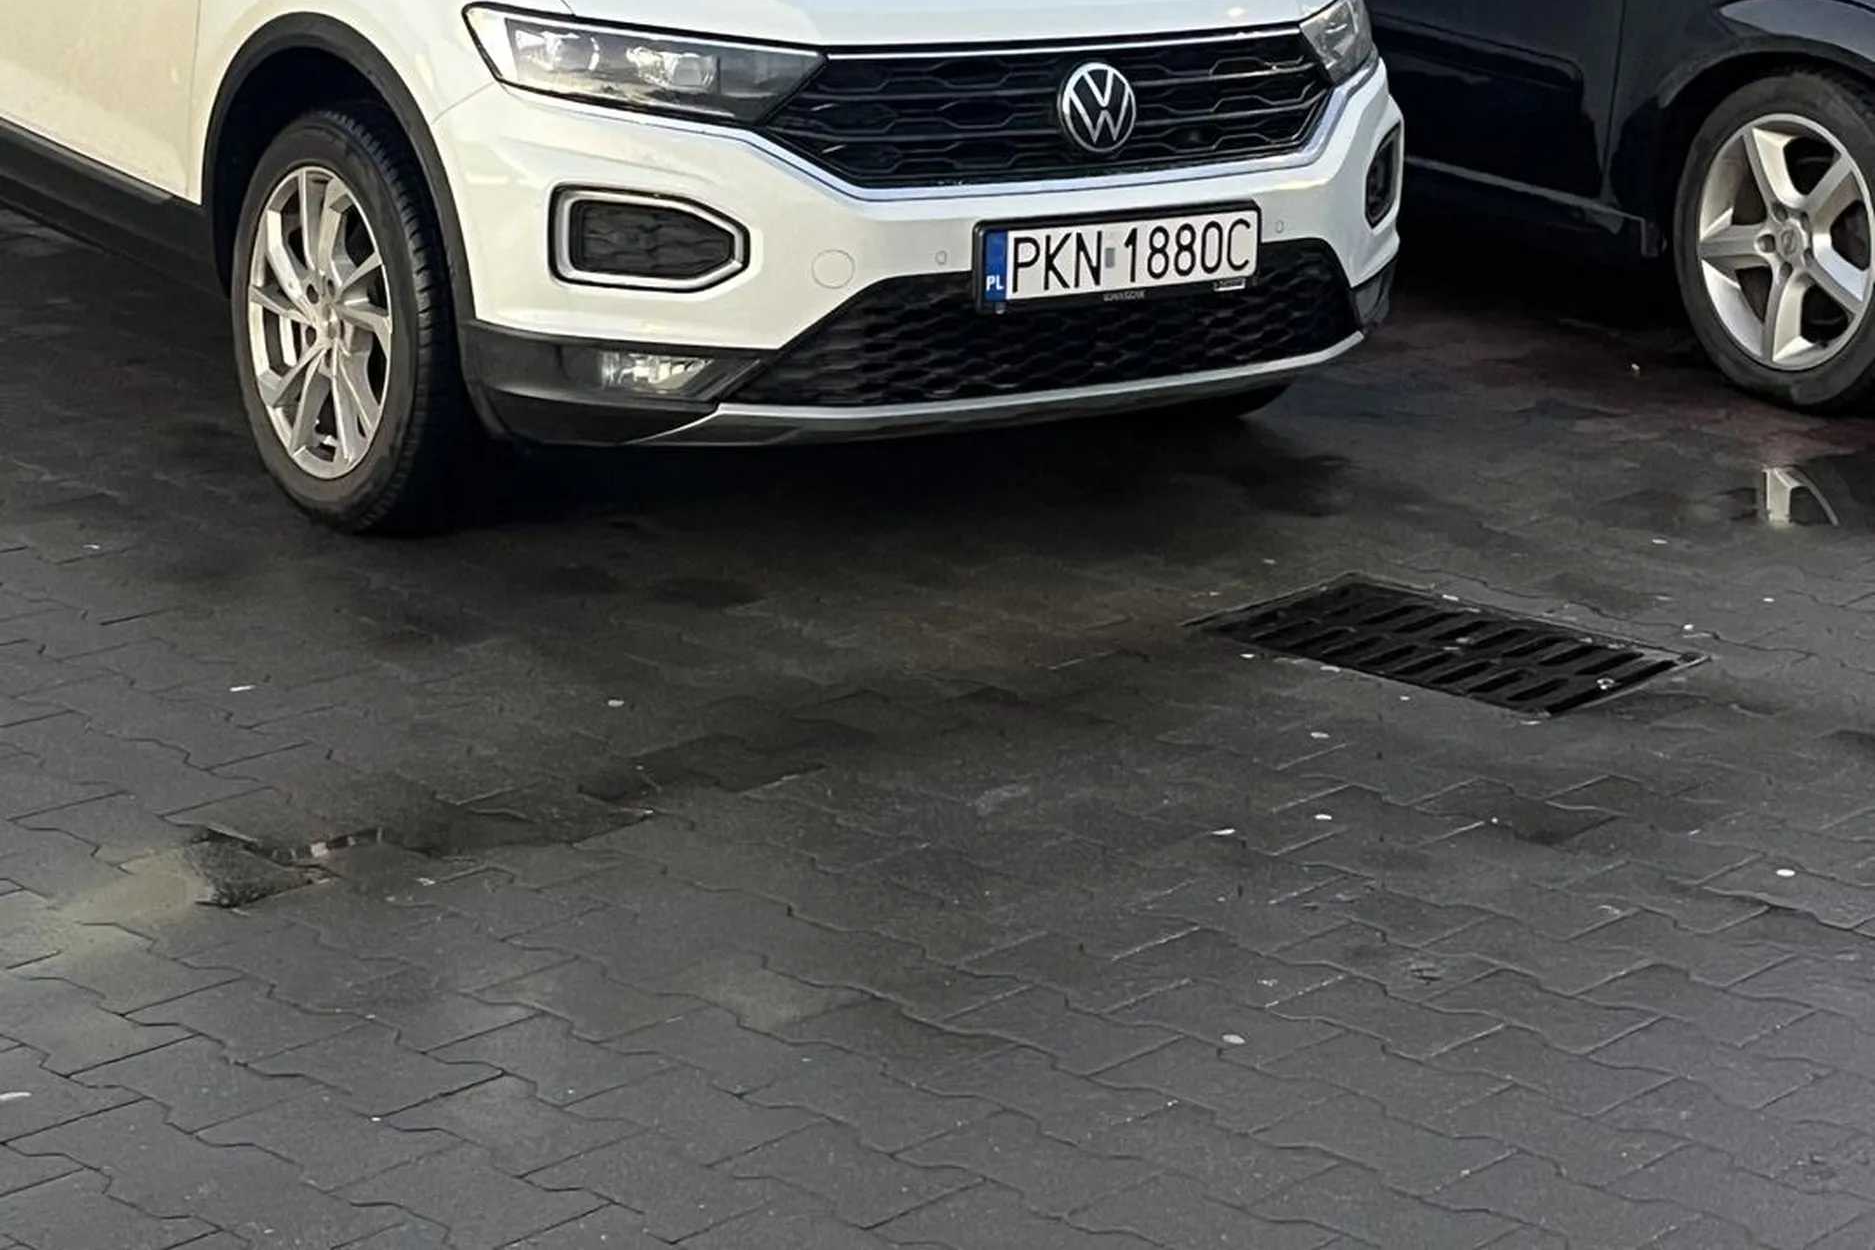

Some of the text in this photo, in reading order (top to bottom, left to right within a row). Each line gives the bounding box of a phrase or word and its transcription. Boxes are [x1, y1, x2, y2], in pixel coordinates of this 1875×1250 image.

[1064, 63, 1134, 150] VW
[985, 274, 1004, 292] PL
[1011, 218, 1252, 294] PKN 1880C
